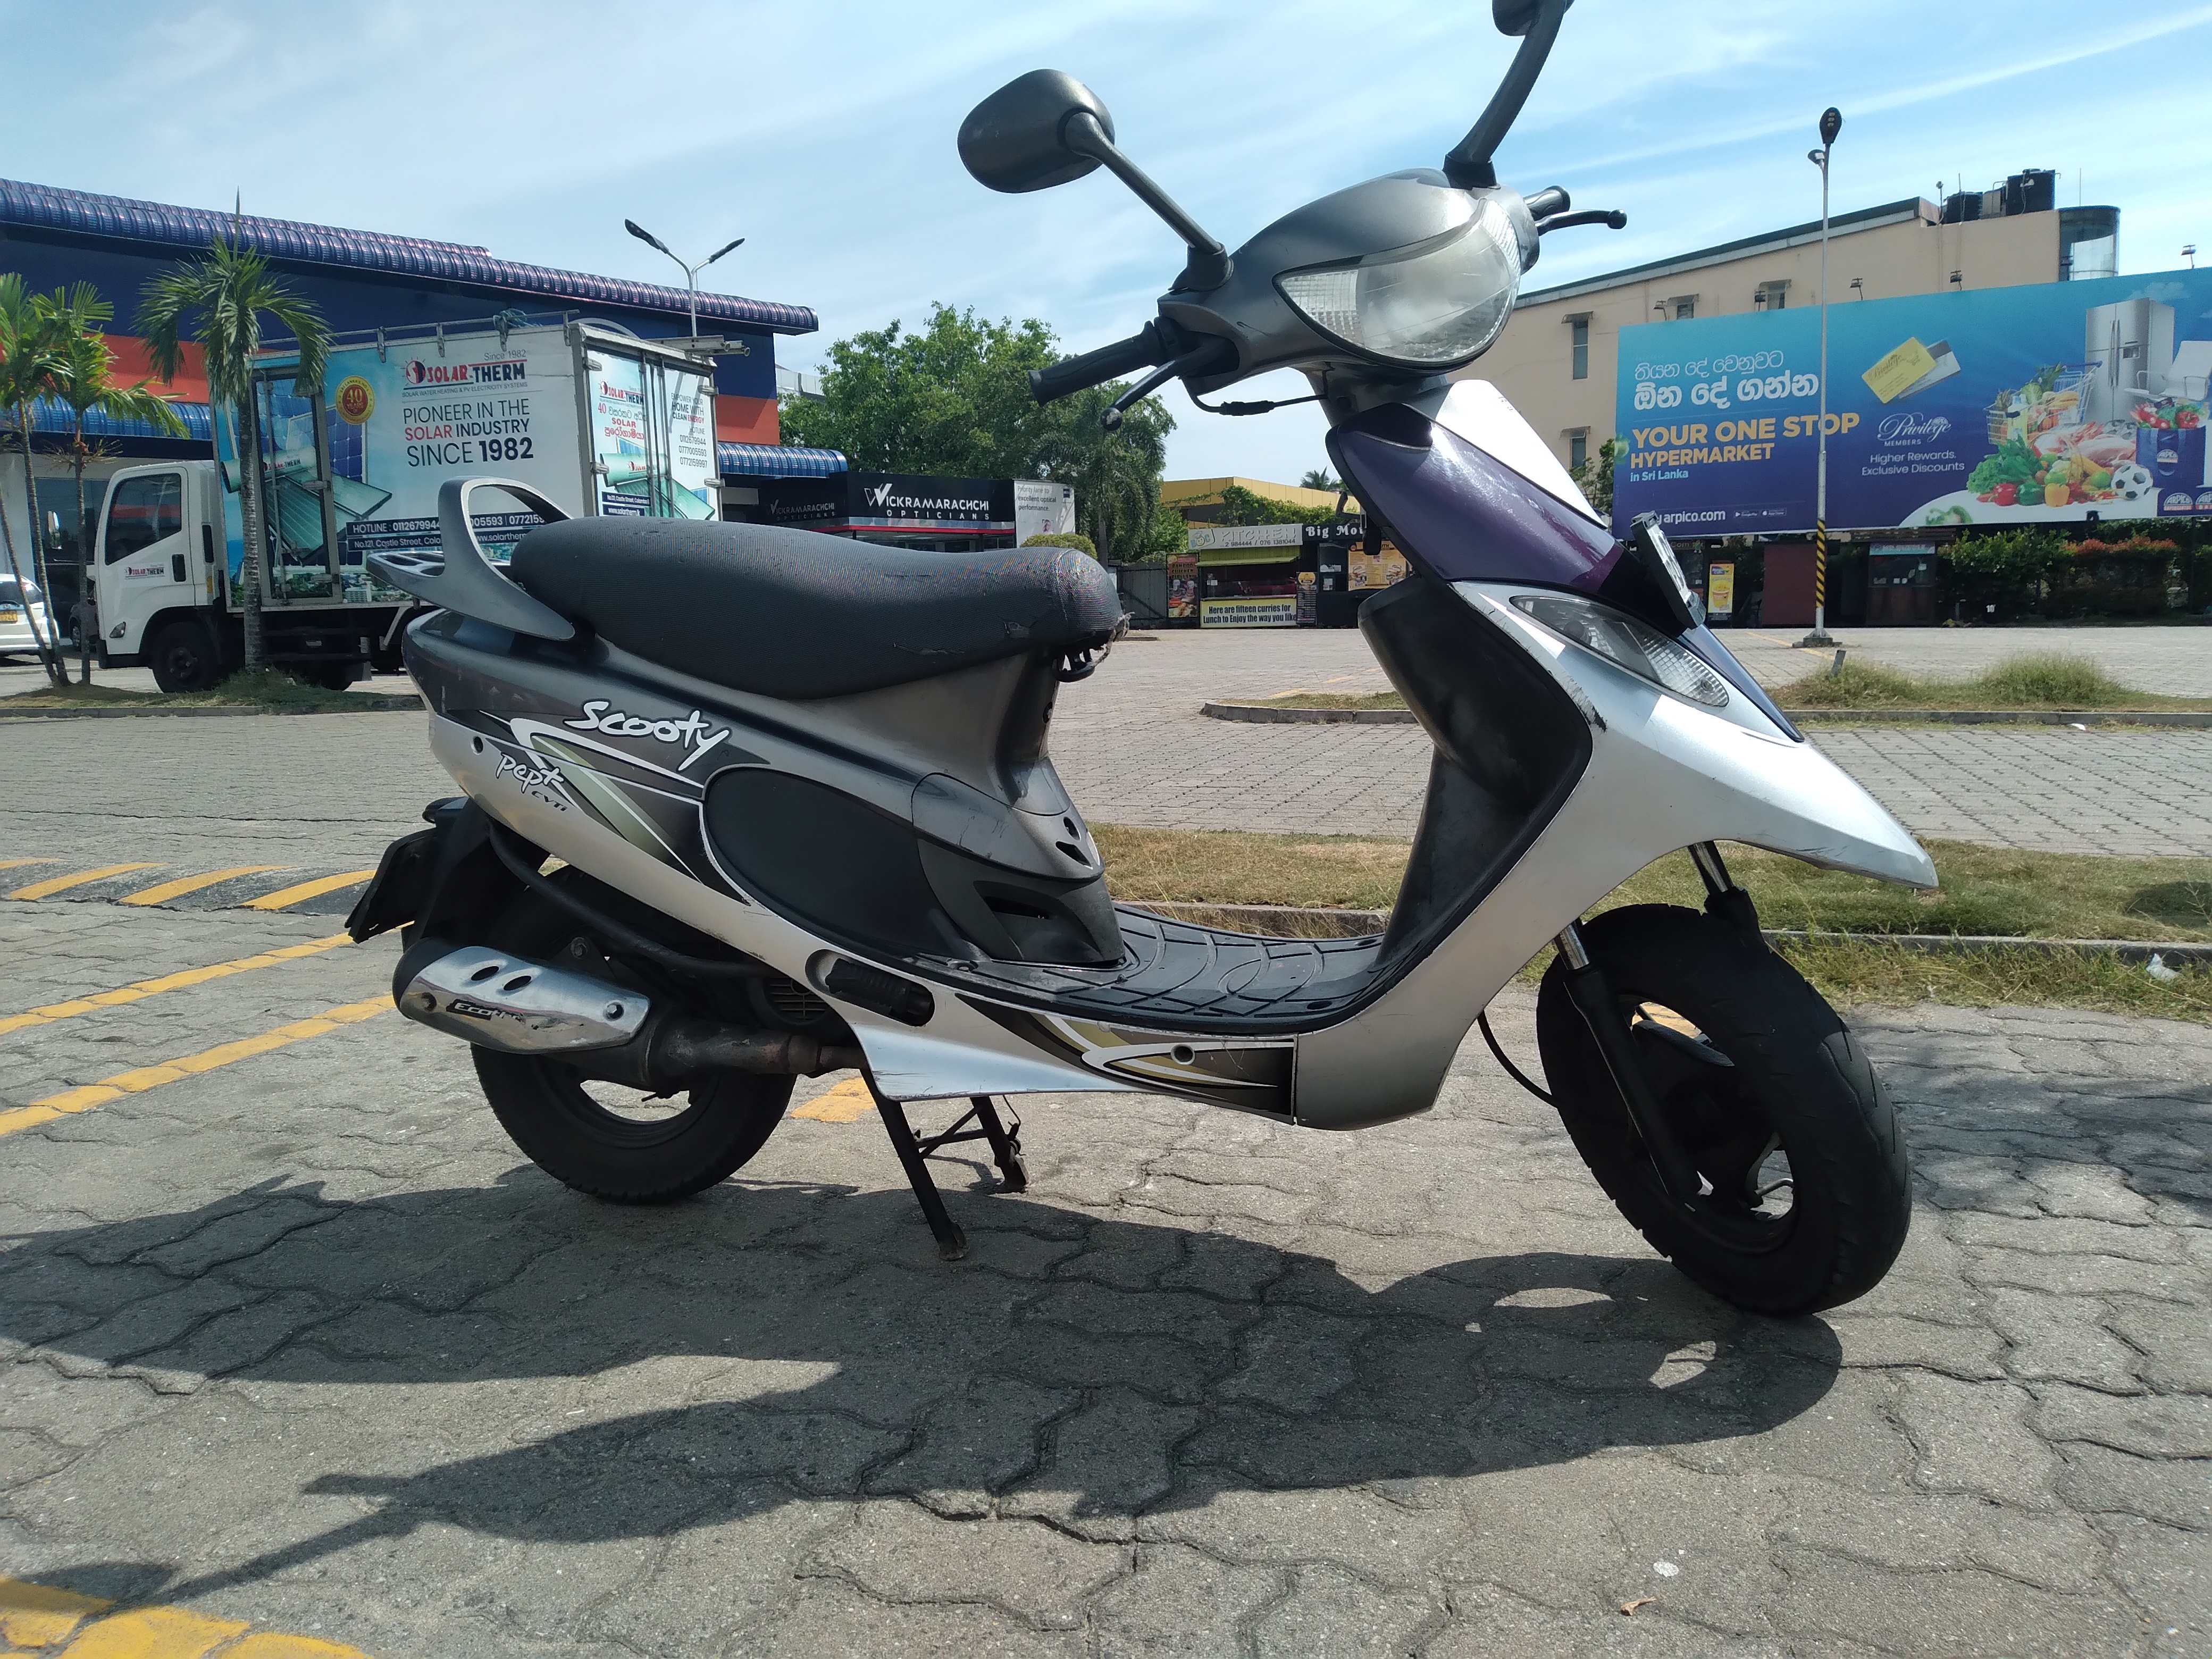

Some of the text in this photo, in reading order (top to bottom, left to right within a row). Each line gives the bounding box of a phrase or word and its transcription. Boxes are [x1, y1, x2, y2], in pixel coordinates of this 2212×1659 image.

[484, 349, 526, 361] Since 1982
[1635, 350, 1783, 380] තියන දේ වෙනුවට
[346, 388, 363, 403] 40
[1634, 370, 1819, 410] ඕන දේ ගන්න
[671, 393, 691, 403] EMPOWER
[403, 398, 530, 424] PIONEER IN THE
[598, 403, 606, 414] 40
[672, 402, 704, 416] HOME WITH
[611, 417, 636, 428] SOLAR
[673, 412, 704, 424] CLEAN ENERGY
[405, 418, 530, 441] SOLAR INDUSTRY
[1632, 412, 1860, 449] YOUR ONE STOP
[1877, 412, 1952, 442] Privilege
[680, 435, 706, 446] 0112679944
[407, 437, 534, 467] SINCE 1982
[679, 446, 707, 457] 0777005593
[1630, 442, 1775, 469] HYPERMARKET
[680, 457, 707, 468] 0772159997
[1870, 453, 1905, 465] Higher
[1630, 468, 1688, 482] in Sri Lanka
[1862, 462, 1965, 476] Exclusive Discounts
[865, 483, 989, 510] WICKRAMARACHCHI
[887, 509, 989, 520] OPTICIANS
[1305, 526, 1329, 539] Big
[1230, 615, 1246, 623] Enjoy
[565, 702, 729, 770] Scooty
